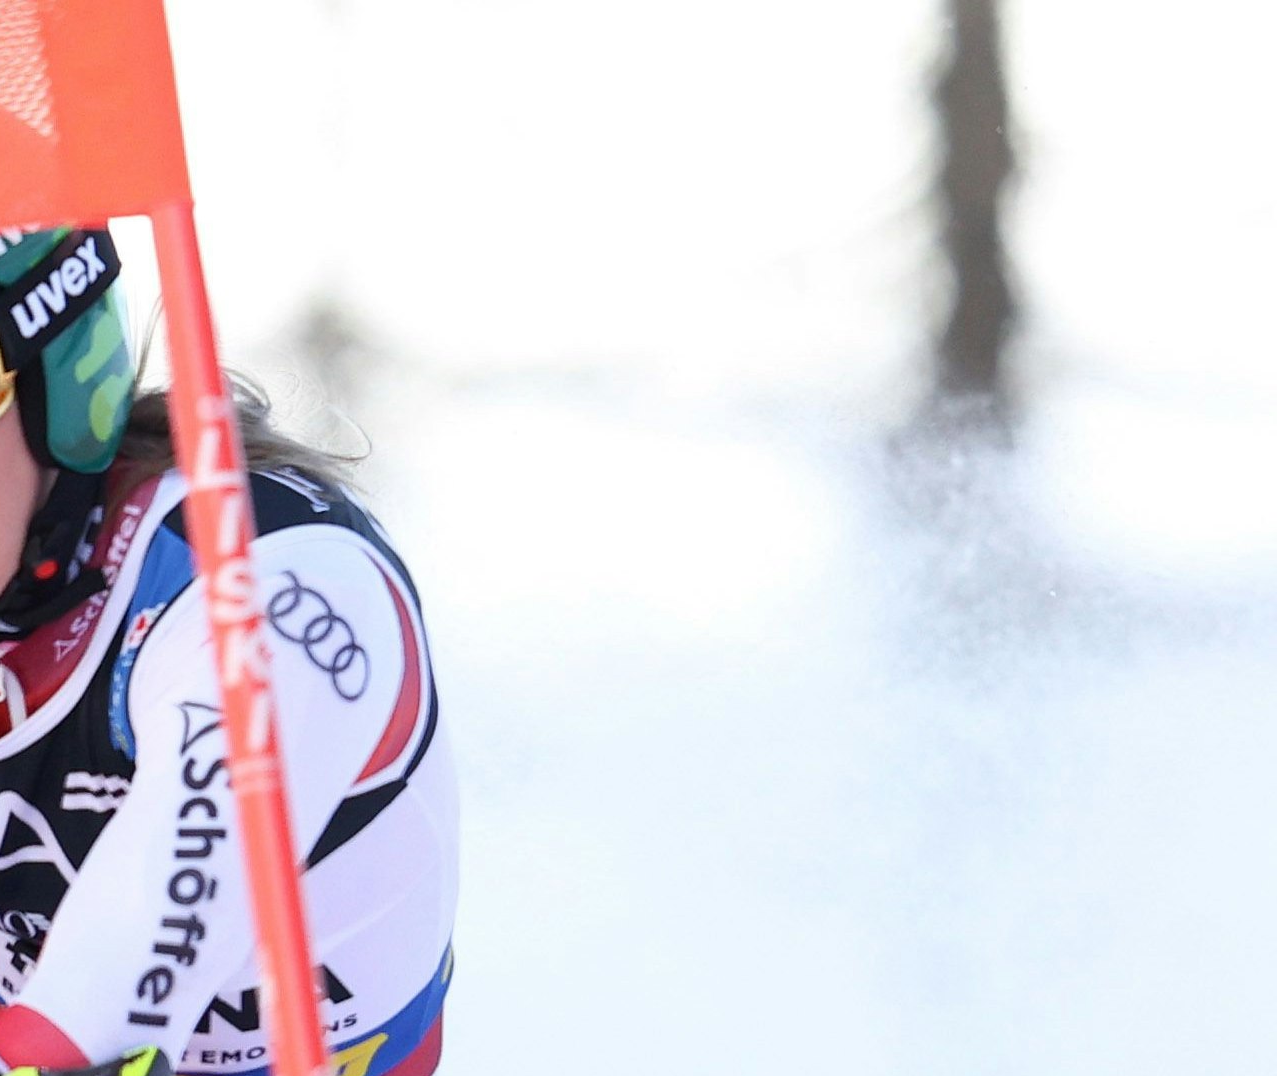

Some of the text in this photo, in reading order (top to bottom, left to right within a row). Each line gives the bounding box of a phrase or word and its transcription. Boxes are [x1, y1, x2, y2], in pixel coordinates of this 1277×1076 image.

[10, 236, 106, 339] uvex
[191, 426, 273, 750] LISKI
[127, 756, 234, 1028] Schöffel
